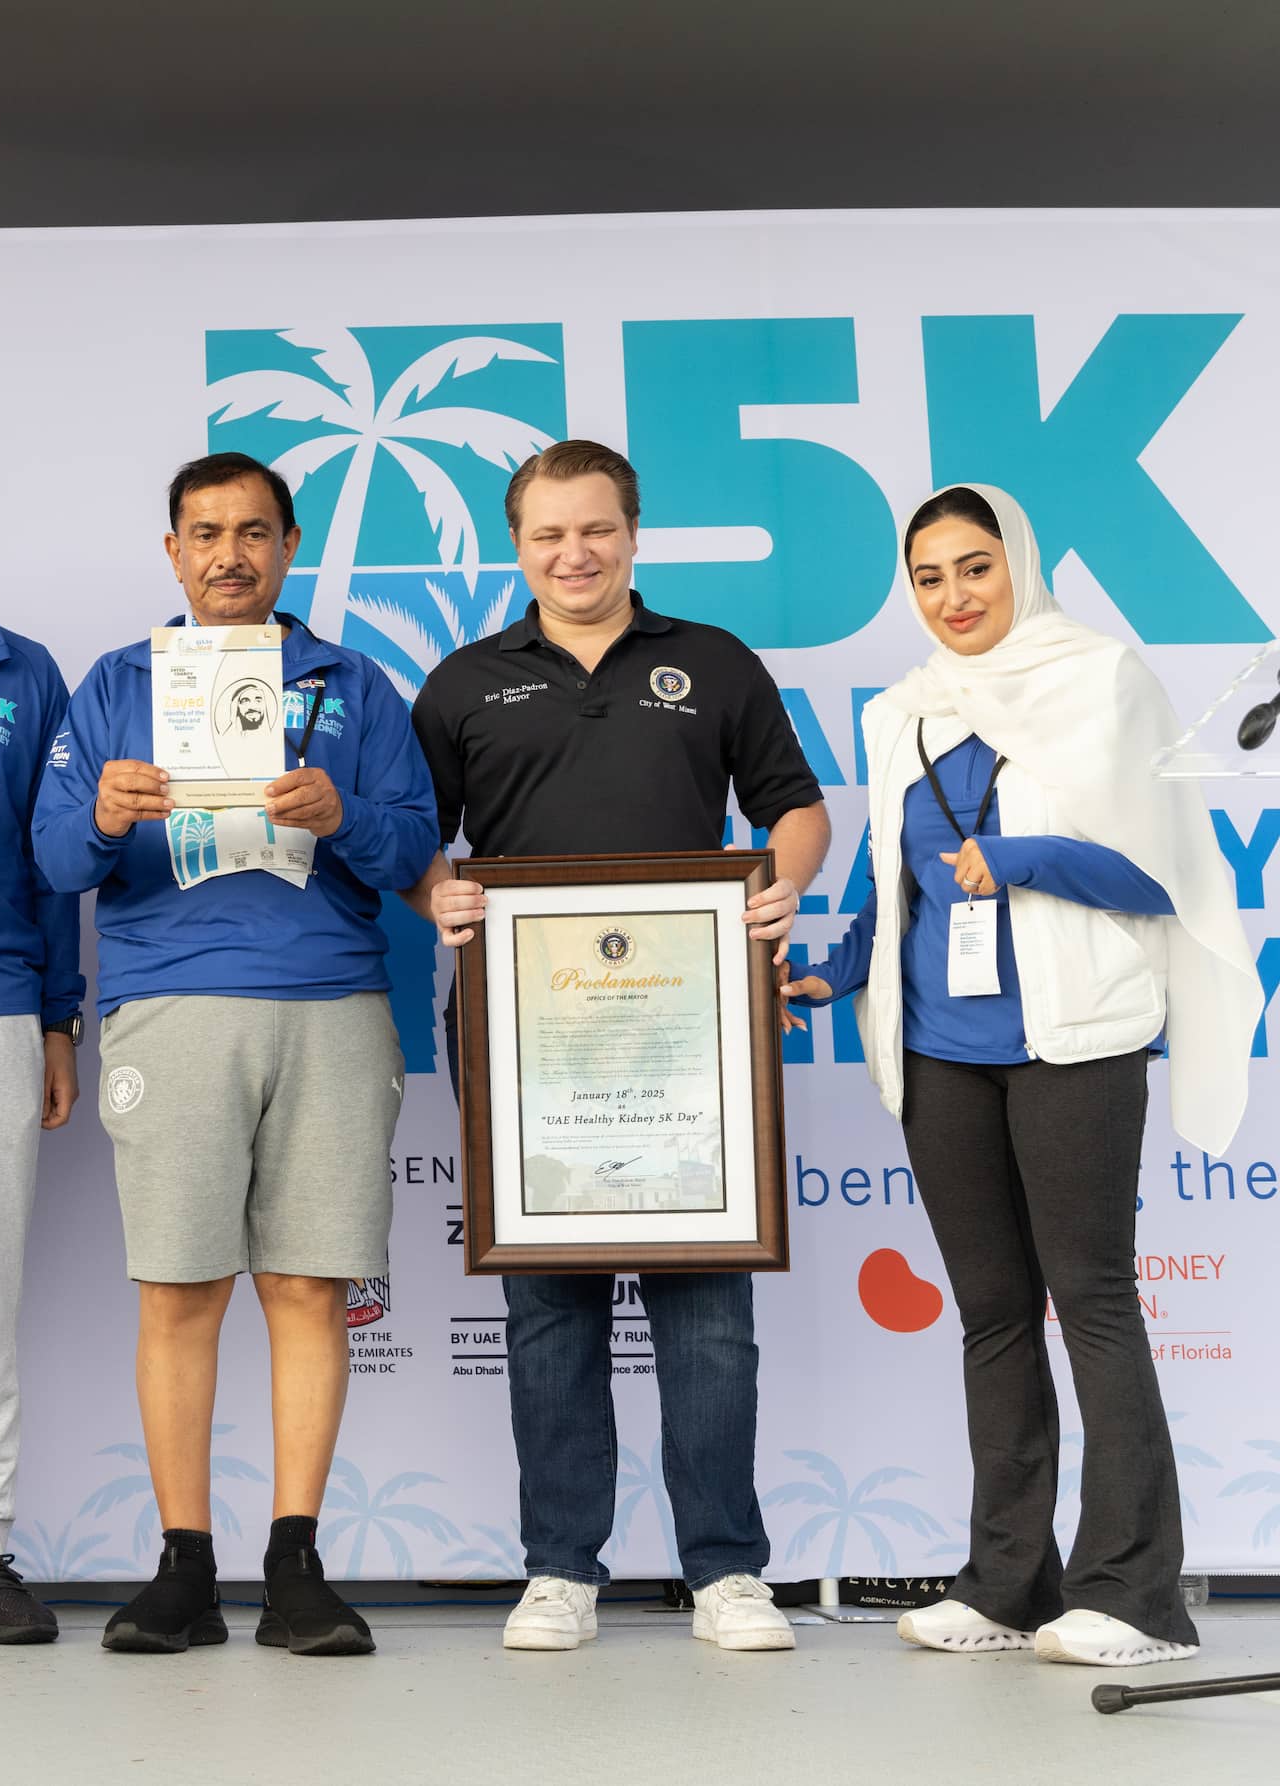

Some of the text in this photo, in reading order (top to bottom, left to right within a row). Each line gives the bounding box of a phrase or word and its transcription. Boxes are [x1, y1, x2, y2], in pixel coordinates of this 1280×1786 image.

[622, 313, 1277, 650] 5K
[485, 693, 500, 702] Eric
[503, 693, 530, 704] Mayor
[639, 699, 653, 708] City
[678, 705, 697, 715] Miami
[551, 967, 683, 991] Proclamation
[571, 1090, 612, 1102] January
[641, 1089, 665, 1099] 2025
[575, 1114, 615, 1126] Healthy
[619, 1112, 654, 1125] Kidney
[658, 1112, 673, 1123] 5K
[1170, 1151, 1277, 1201] the
[1137, 1254, 1226, 1281] IDNEY
[352, 1332, 393, 1342] OF THE
[450, 1333, 501, 1344] BY UAE
[625, 1332, 653, 1343] RUN
[358, 1347, 413, 1358] EMIRATES
[1151, 1344, 1232, 1360] of Florida
[379, 1363, 396, 1373] DC
[453, 1366, 504, 1375] Abu Dhabi
[633, 1365, 655, 1374] 2001
[860, 1595, 917, 1607] AGENCY44.NET
